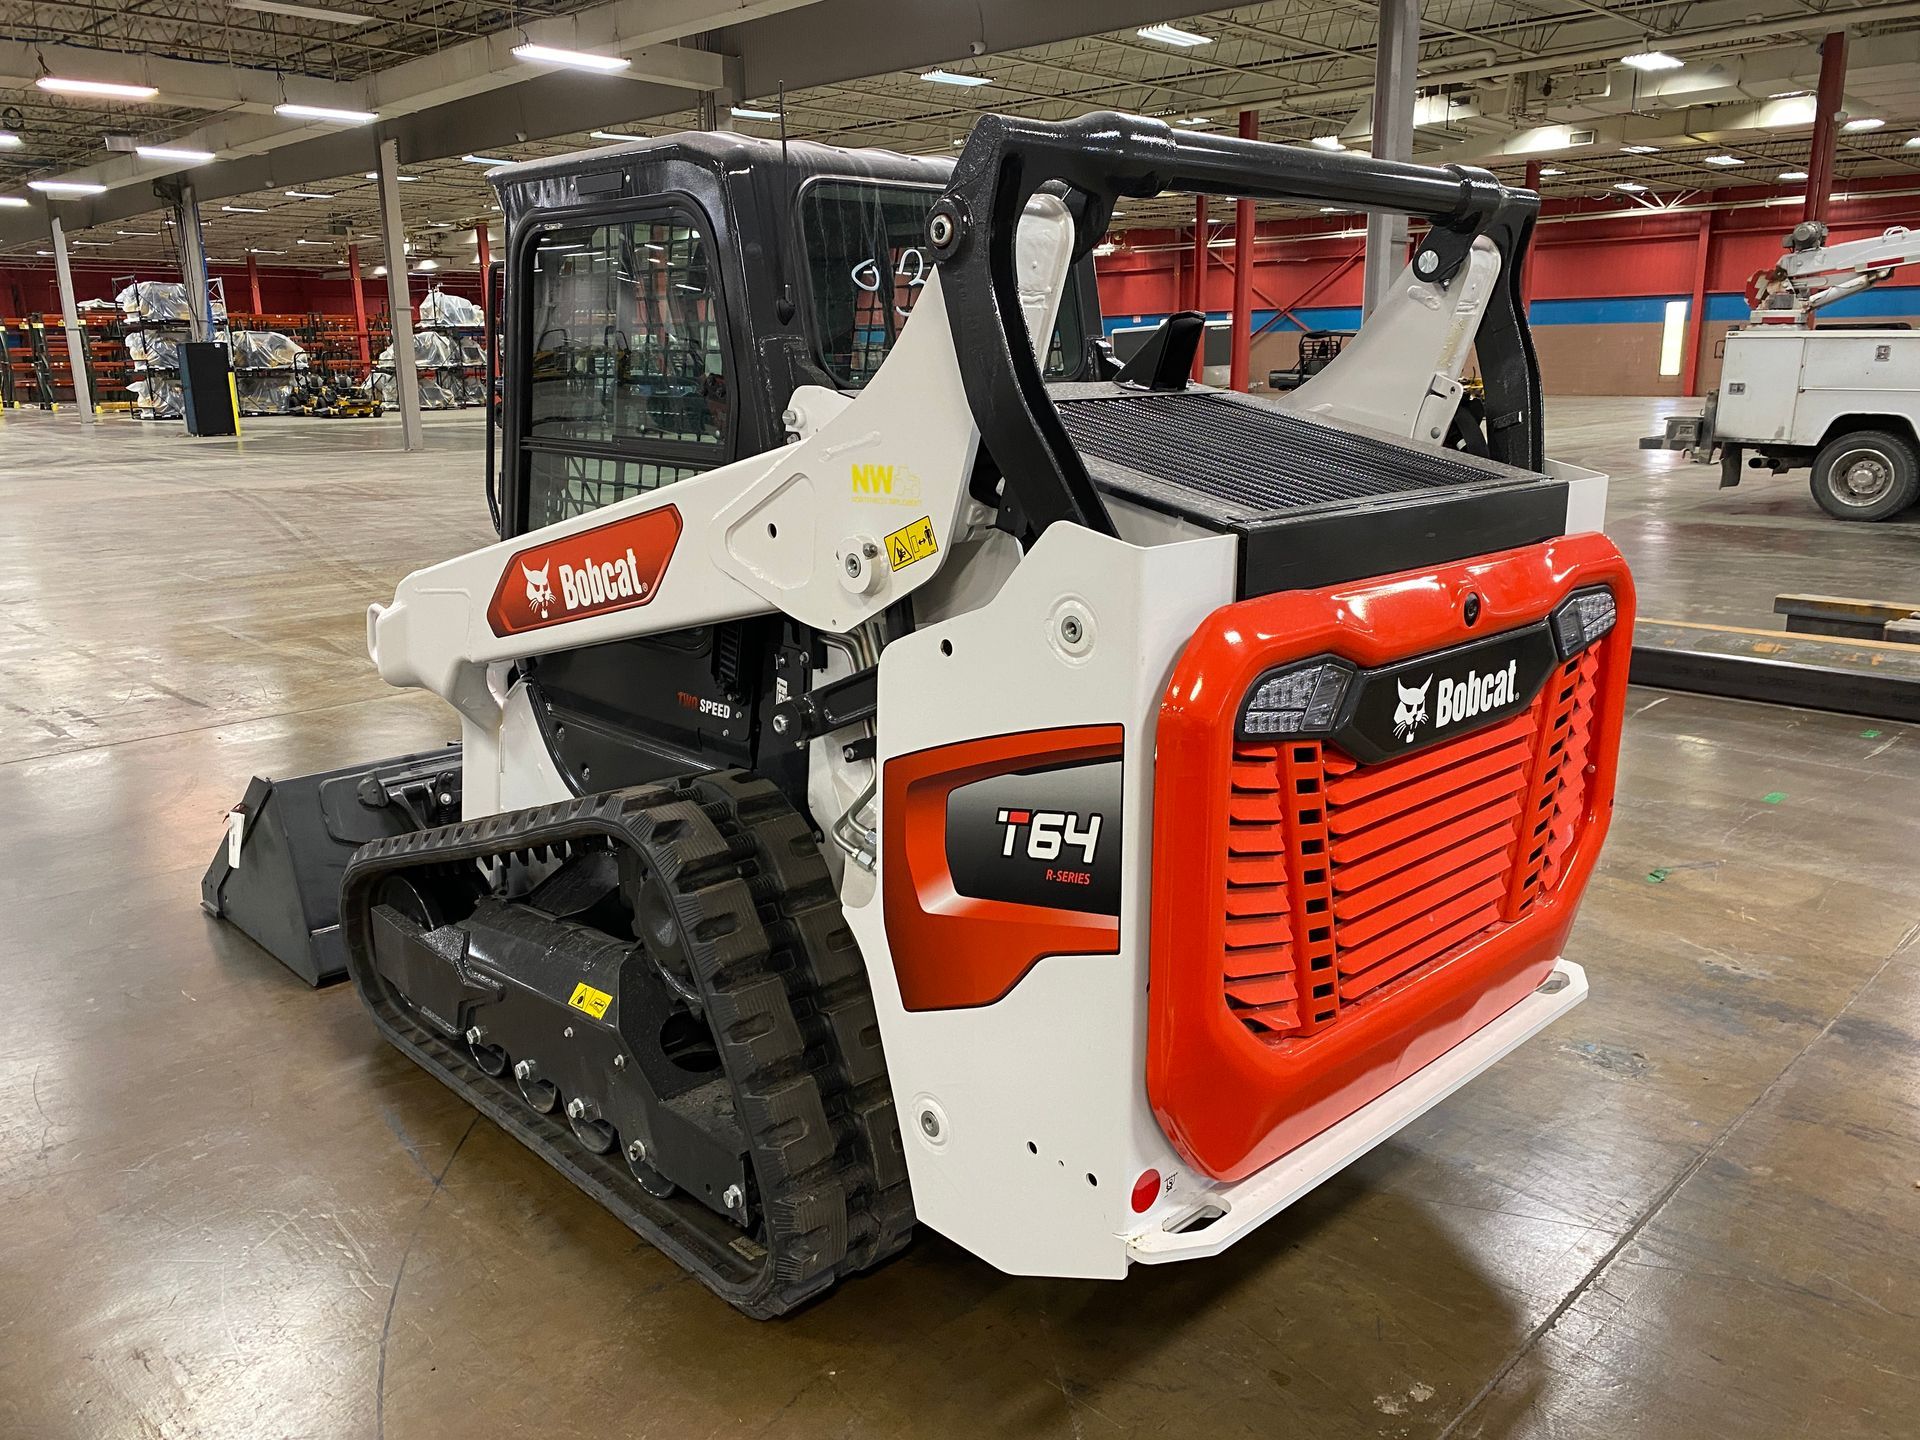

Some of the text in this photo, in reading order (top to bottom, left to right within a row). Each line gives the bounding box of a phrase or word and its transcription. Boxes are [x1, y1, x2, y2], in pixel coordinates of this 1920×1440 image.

[851, 463, 895, 495] NW
[558, 548, 642, 610] Bobcat
[677, 691, 731, 719] TWO SPEED
[1435, 659, 1517, 729] Bobcat
[998, 810, 1102, 864] T64
[1045, 869, 1091, 885] R-SERIES
